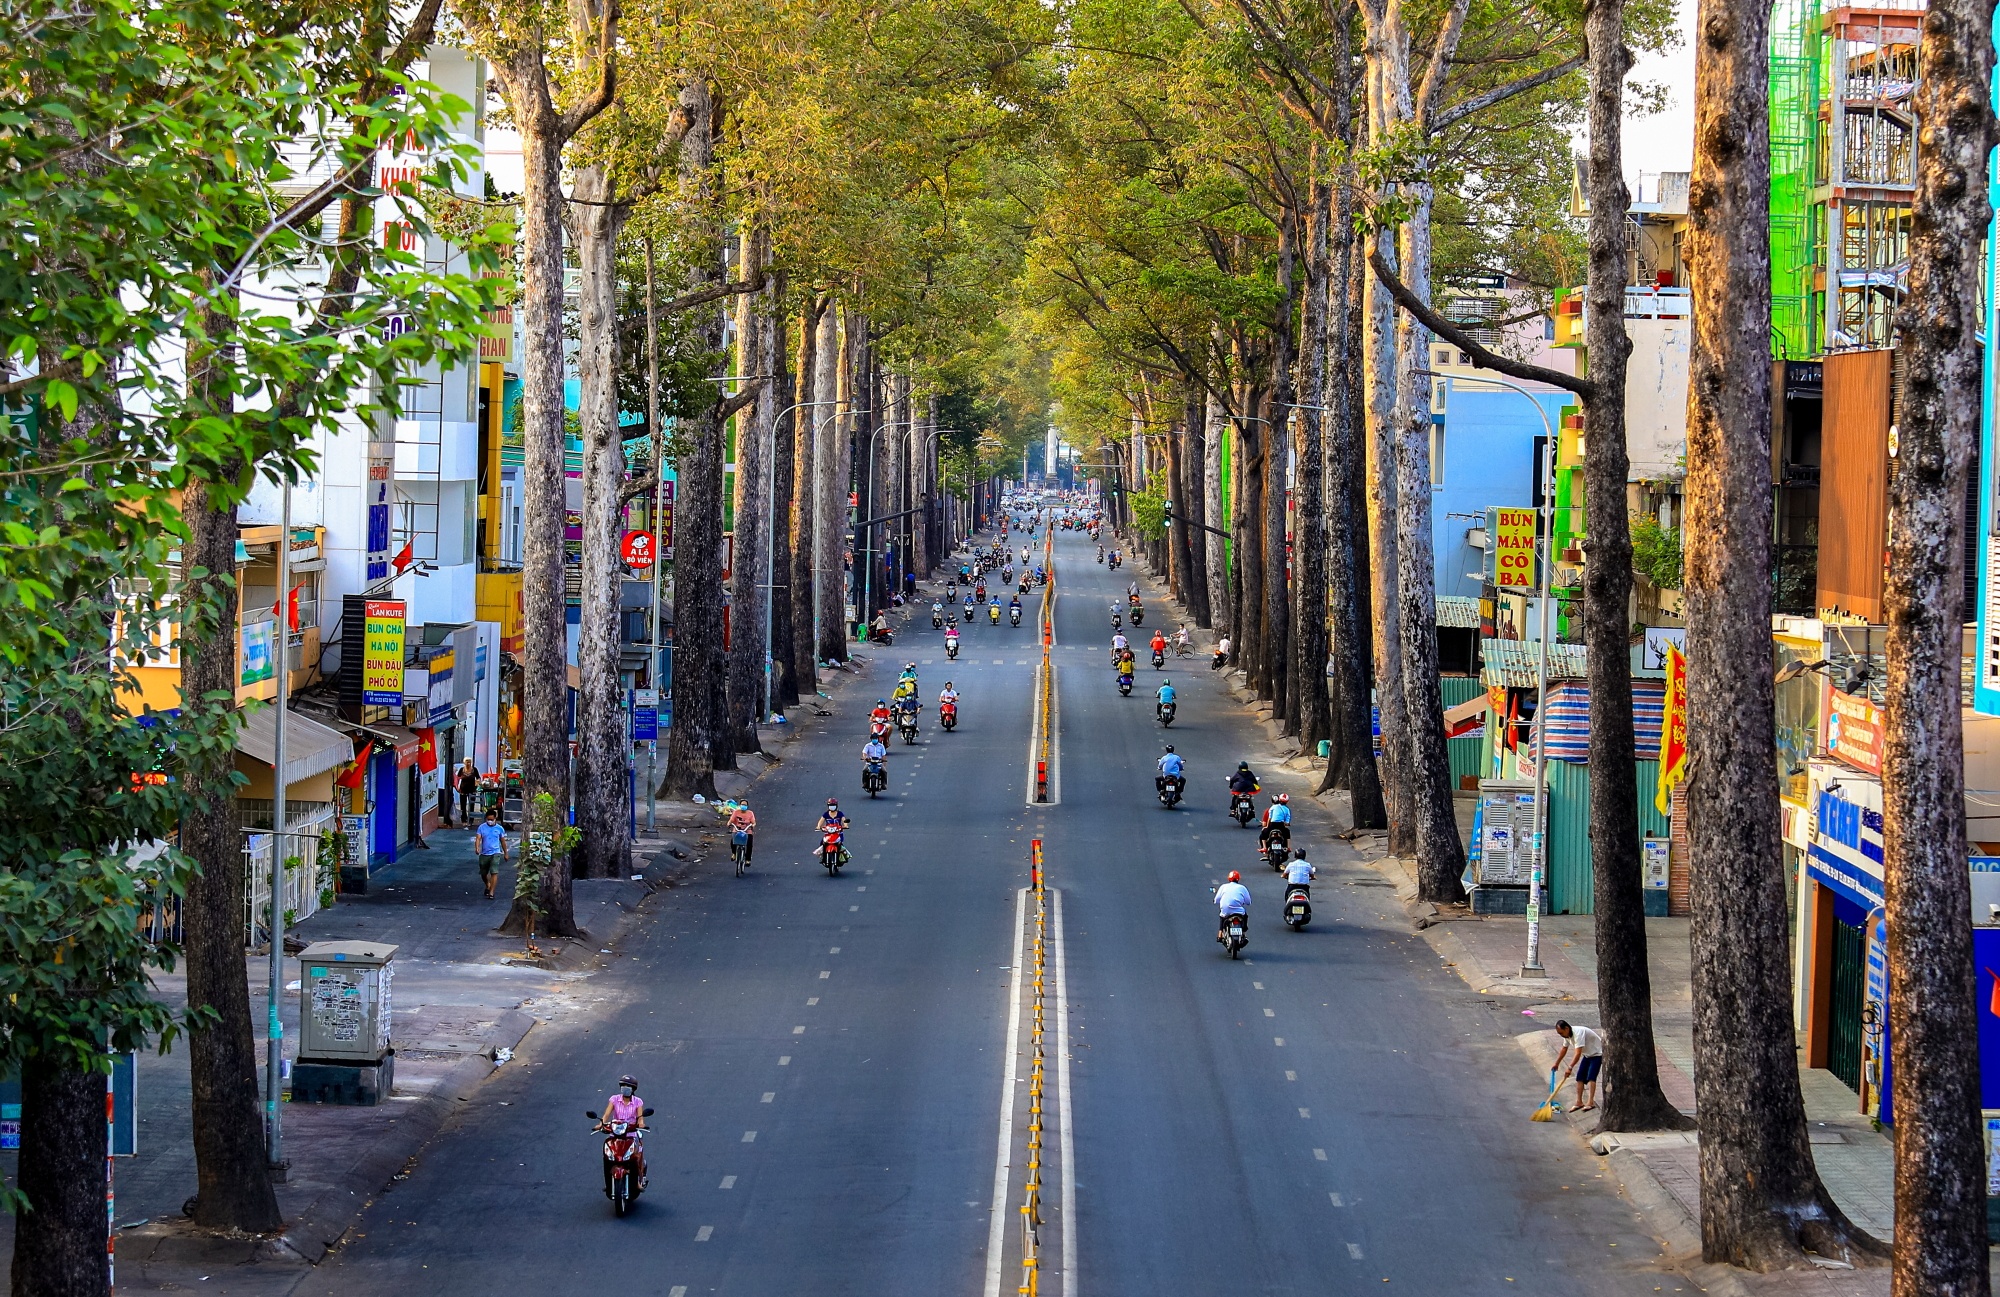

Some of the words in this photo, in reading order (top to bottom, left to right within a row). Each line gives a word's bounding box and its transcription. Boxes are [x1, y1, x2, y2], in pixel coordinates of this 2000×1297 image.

[480, 338, 506, 357] GIAN
[1500, 510, 1533, 527] BÚN
[1497, 529, 1534, 549] MẮM
[637, 556, 653, 565] VIÊN
[1500, 552, 1529, 568] CÔ
[1500, 572, 1529, 586] BA
[385, 609, 403, 617] KUTE
[367, 621, 384, 634] BÚN
[384, 639, 399, 655] NỘI
[366, 657, 383, 670] BÚN
[385, 658, 402, 673] ĐẬU
[368, 673, 385, 687] PHỐ
